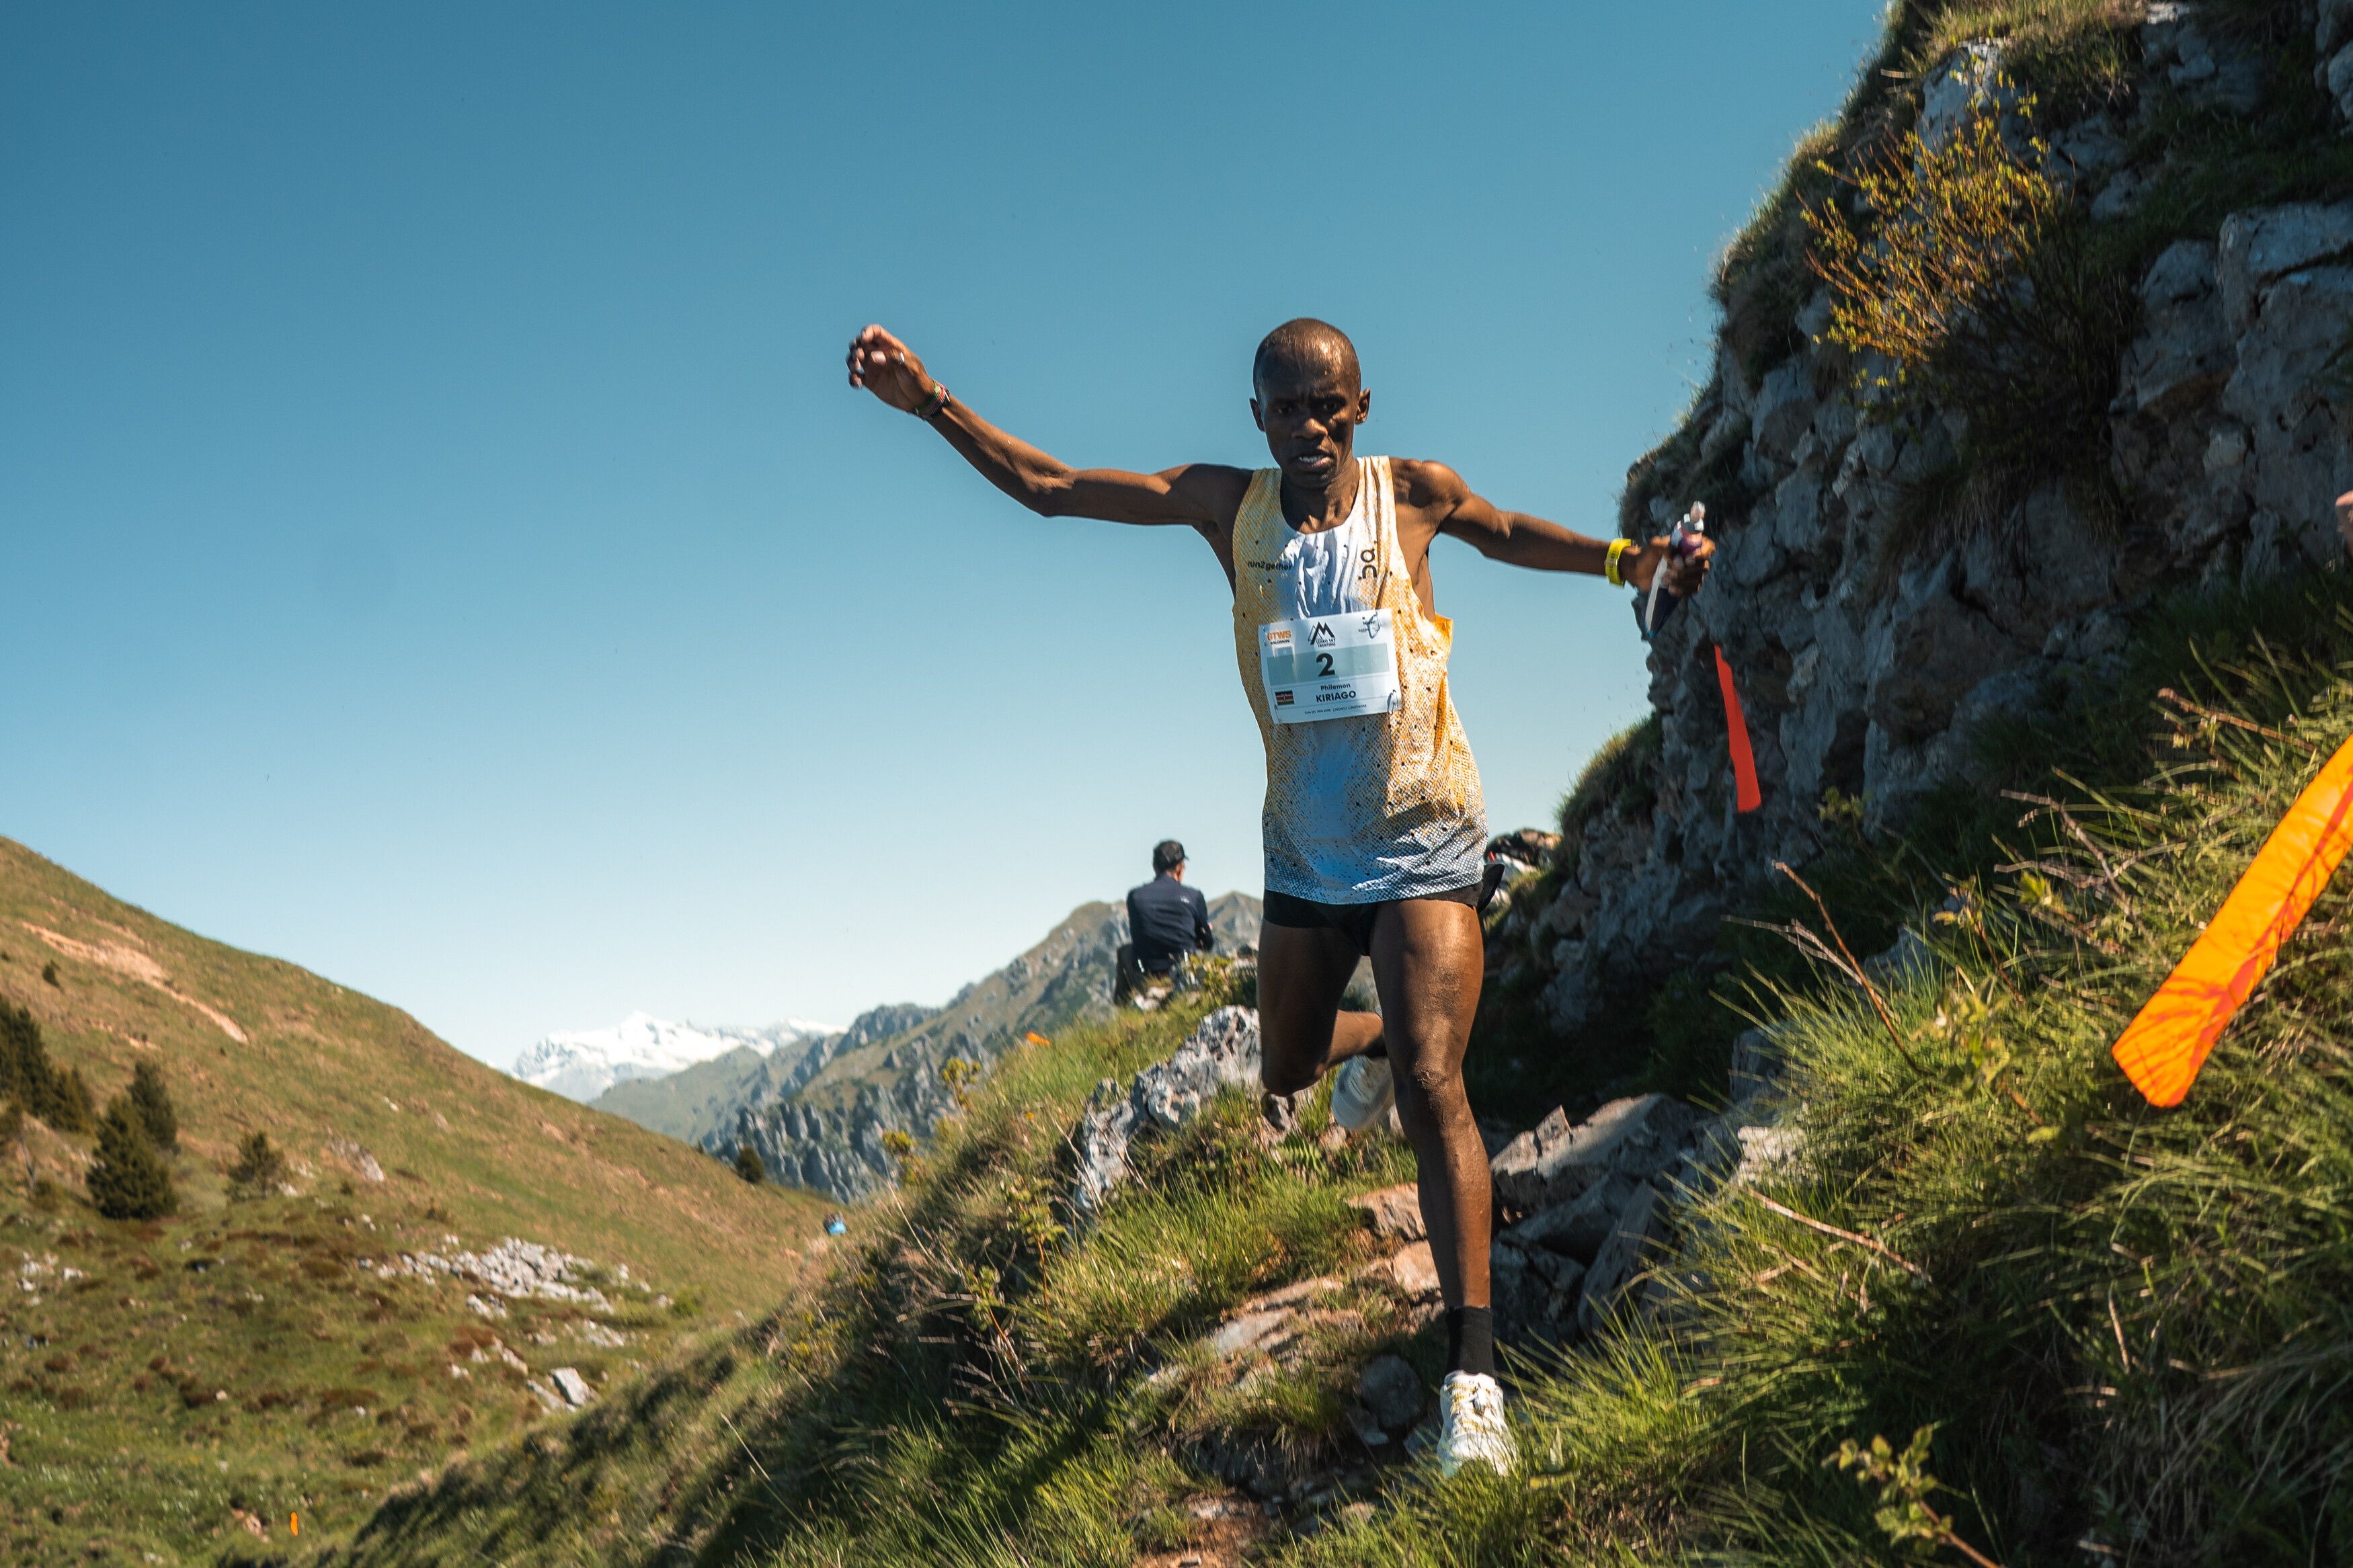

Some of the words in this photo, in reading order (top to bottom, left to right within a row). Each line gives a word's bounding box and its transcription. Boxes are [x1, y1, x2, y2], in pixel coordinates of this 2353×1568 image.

[1267, 630, 1291, 641] GTWS
[1316, 653, 1335, 677] 2
[1320, 683, 1351, 692] Philemon
[1316, 690, 1357, 703] KIRIAGO
